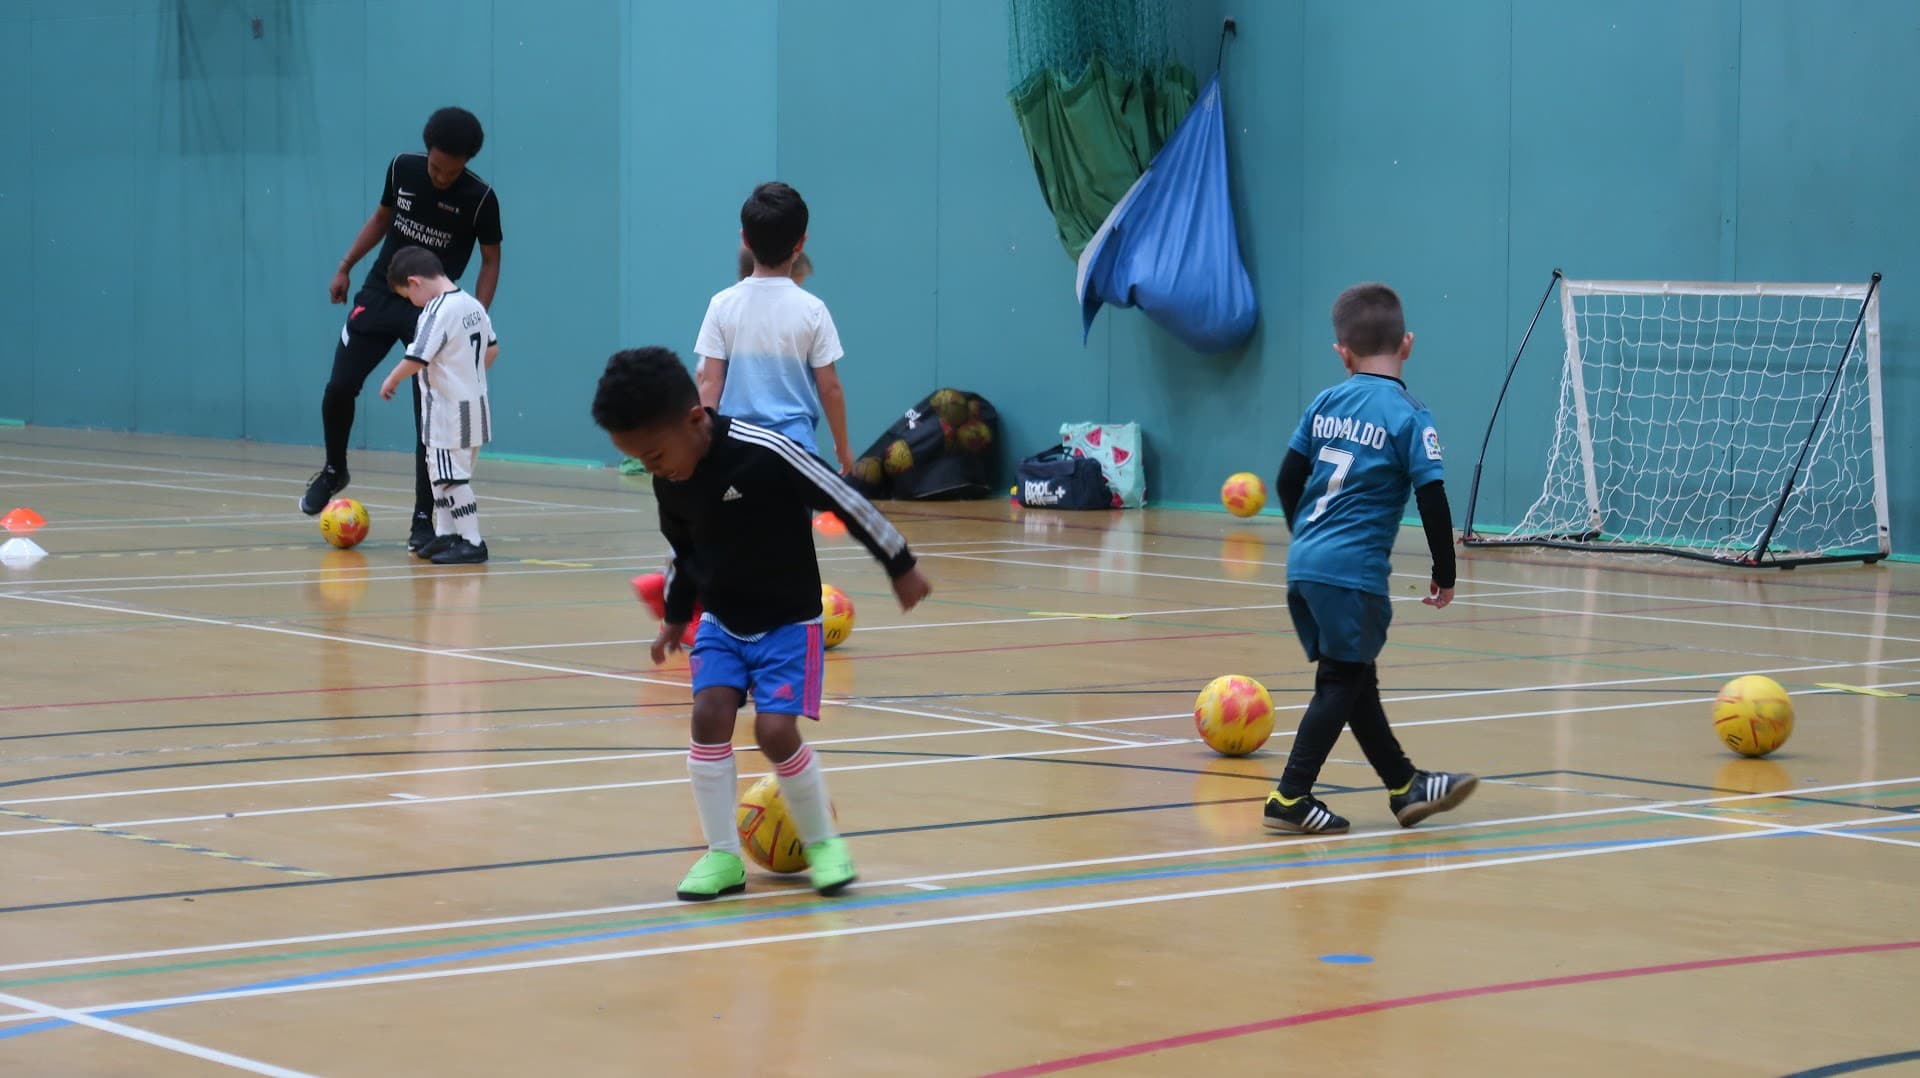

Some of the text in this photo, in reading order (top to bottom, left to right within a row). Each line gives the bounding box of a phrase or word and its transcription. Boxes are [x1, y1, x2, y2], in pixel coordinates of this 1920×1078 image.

[397, 196, 412, 211] RSS
[469, 331, 481, 384] 7
[1312, 414, 1387, 450] RONALDO
[1306, 445, 1355, 522] 7
